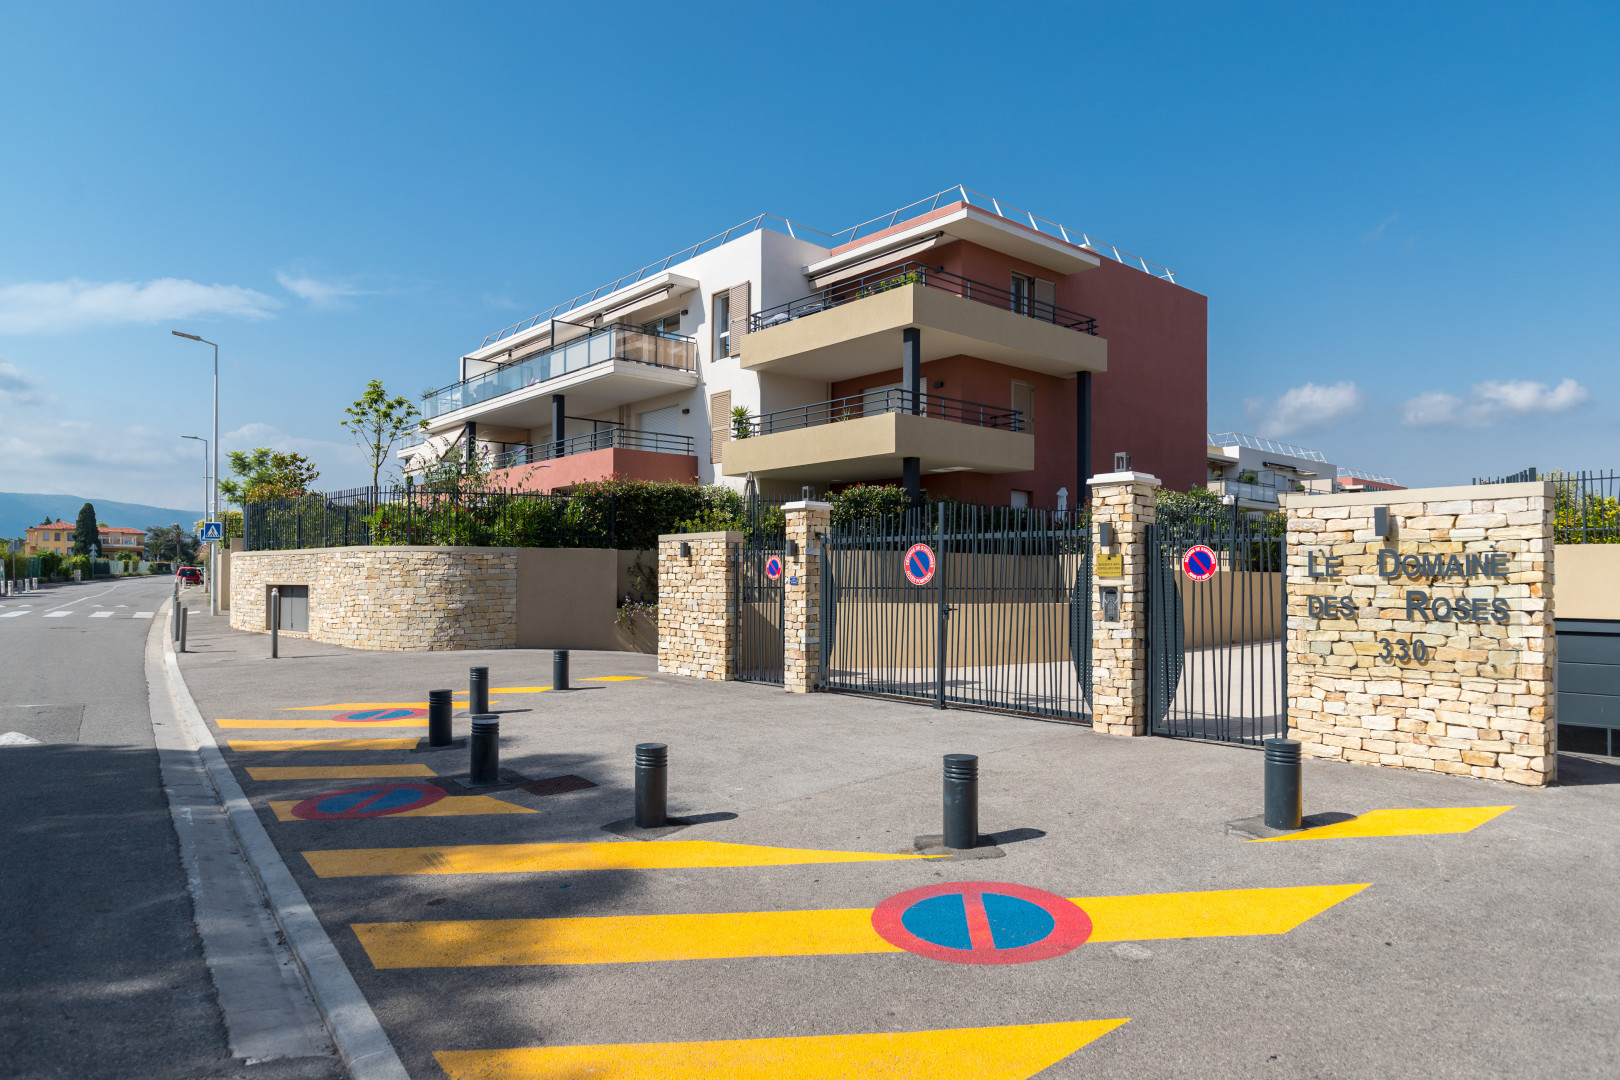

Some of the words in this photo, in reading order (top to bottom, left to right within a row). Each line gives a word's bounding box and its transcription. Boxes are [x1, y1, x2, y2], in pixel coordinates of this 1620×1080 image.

[1308, 551, 1339, 577] LE
[1379, 549, 1507, 577] DOMAINE
[1308, 596, 1355, 617] DES
[1406, 590, 1509, 621] ROSES
[1379, 638, 1426, 661] 330
